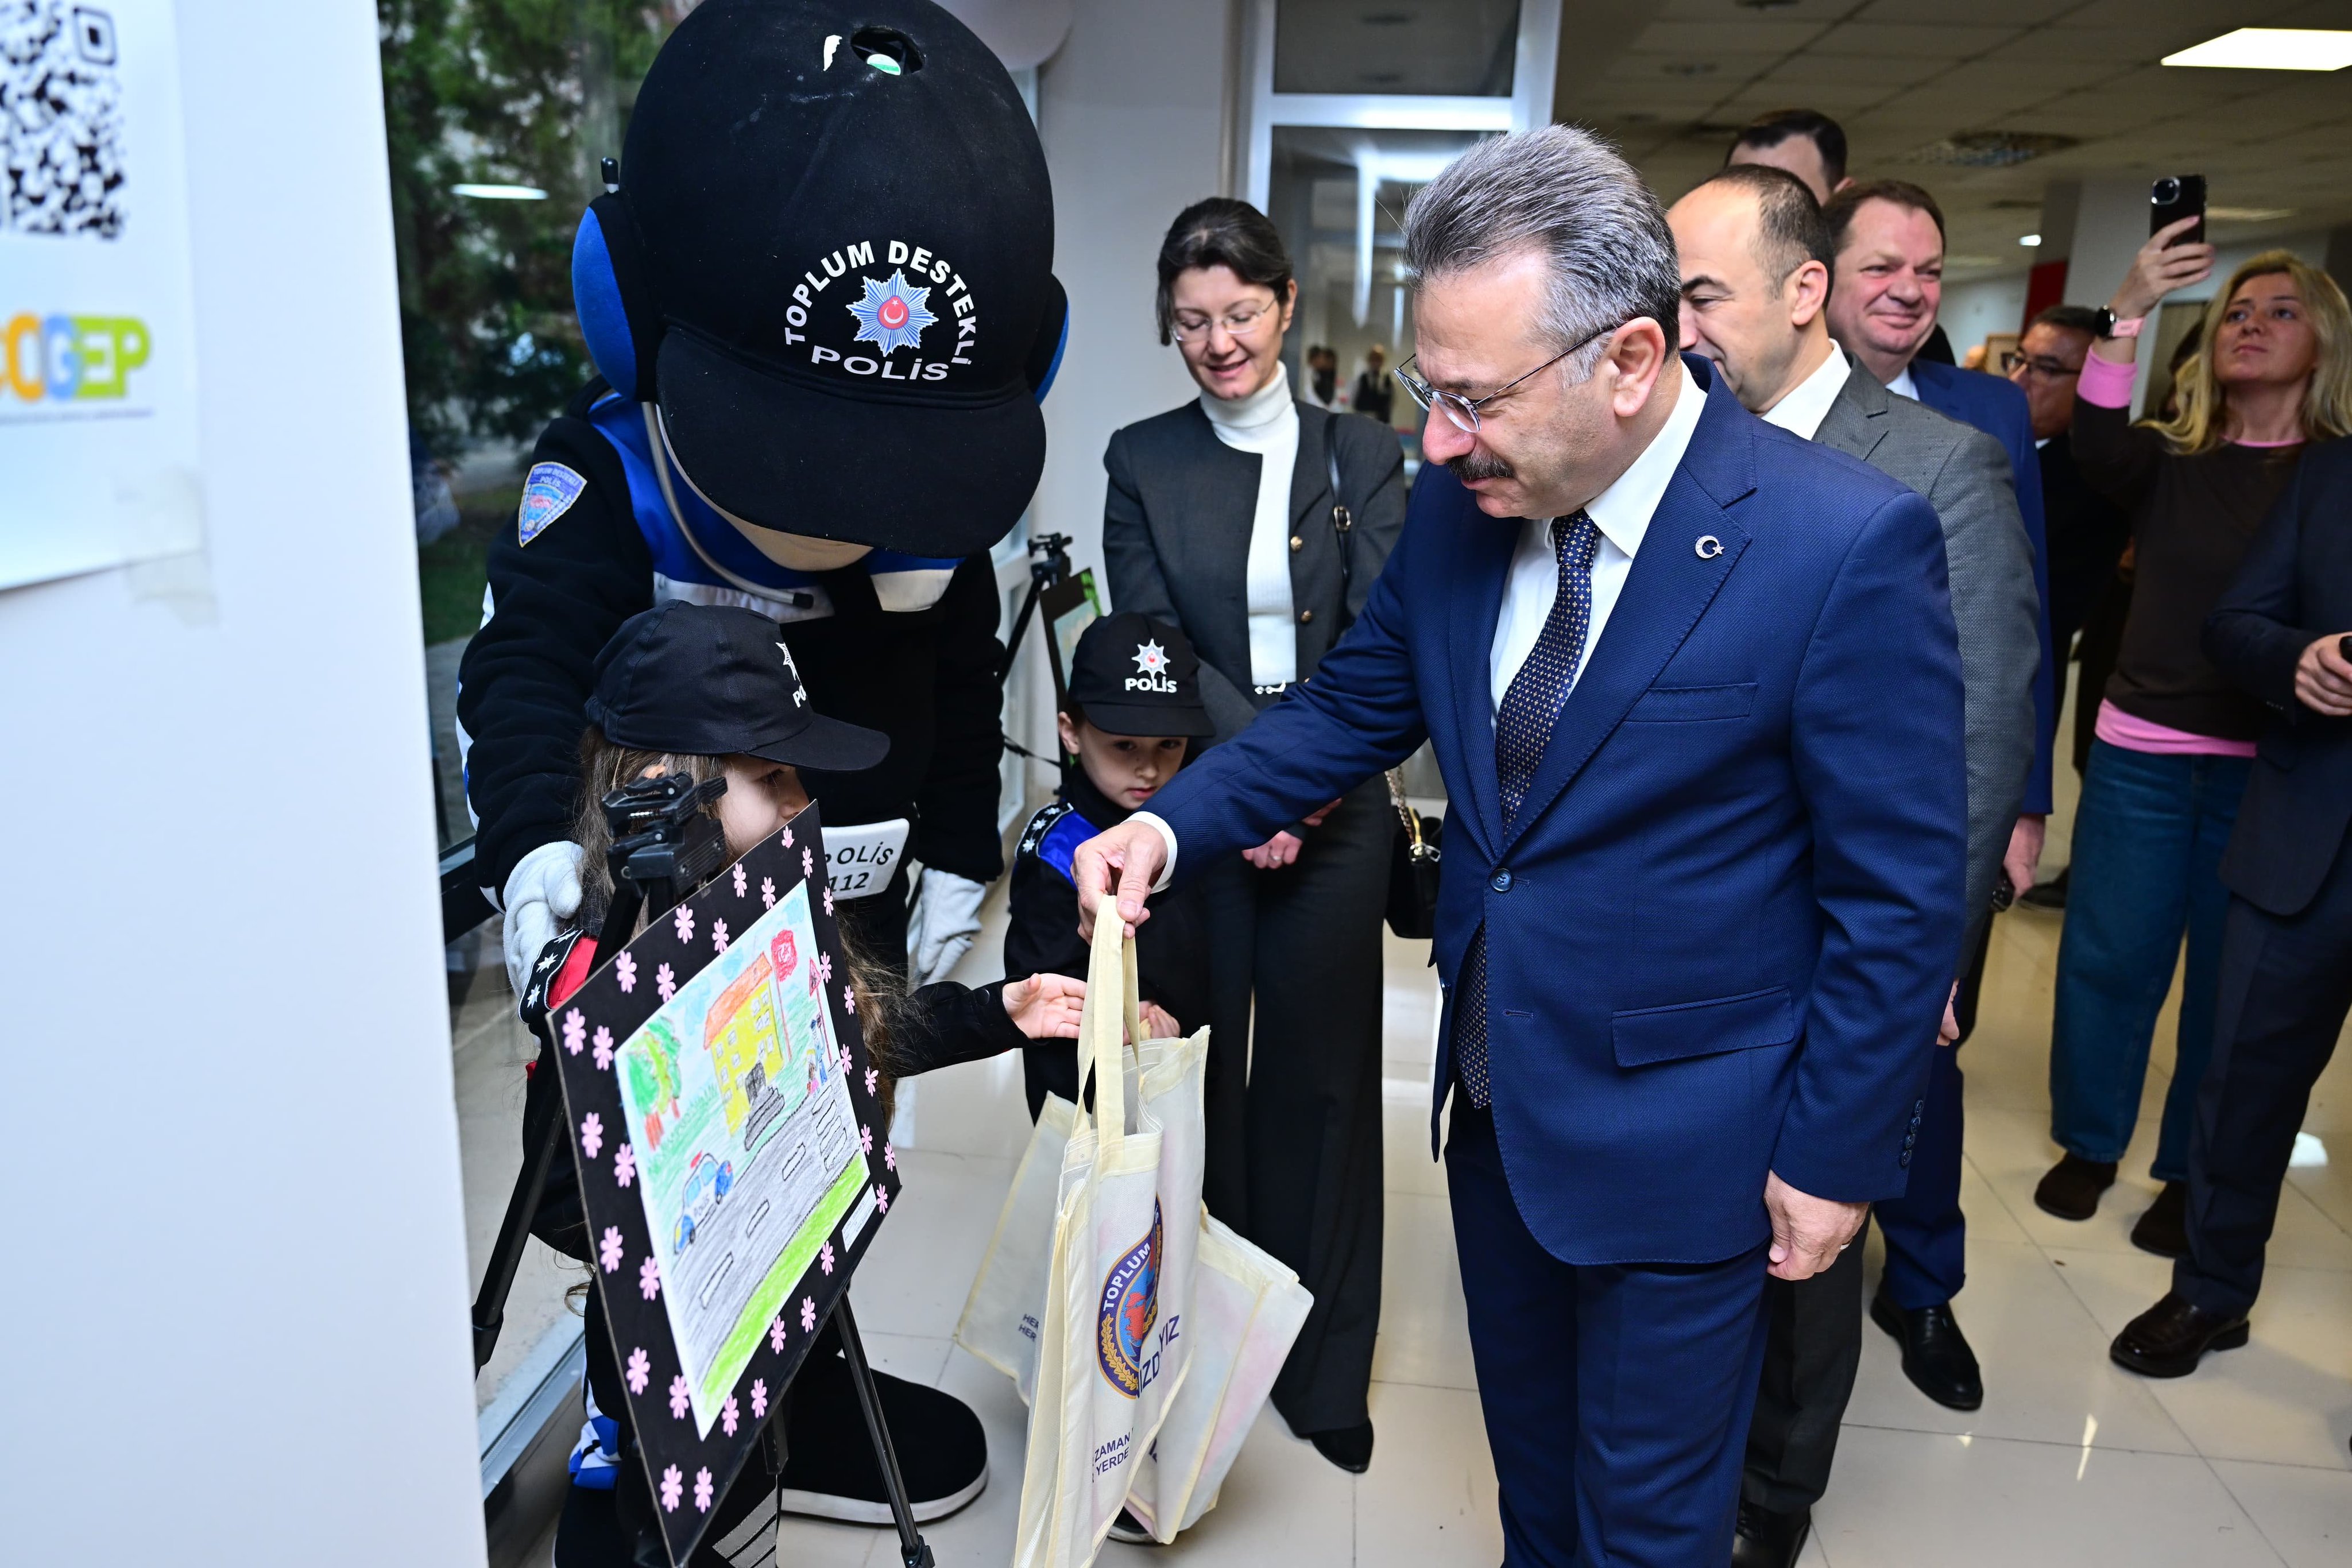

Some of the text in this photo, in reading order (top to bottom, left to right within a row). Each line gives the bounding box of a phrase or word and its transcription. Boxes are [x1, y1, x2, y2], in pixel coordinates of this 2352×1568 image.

[784, 239, 976, 365] TOPLUM DESTEKLİ
[829, 872, 869, 892] 112
[1103, 1242, 1151, 1312] TOPLUM
[1018, 1323, 1036, 1342] HER
[1094, 1431, 1130, 1463] ZAMAN
[1096, 1446, 1129, 1481] YERDE
